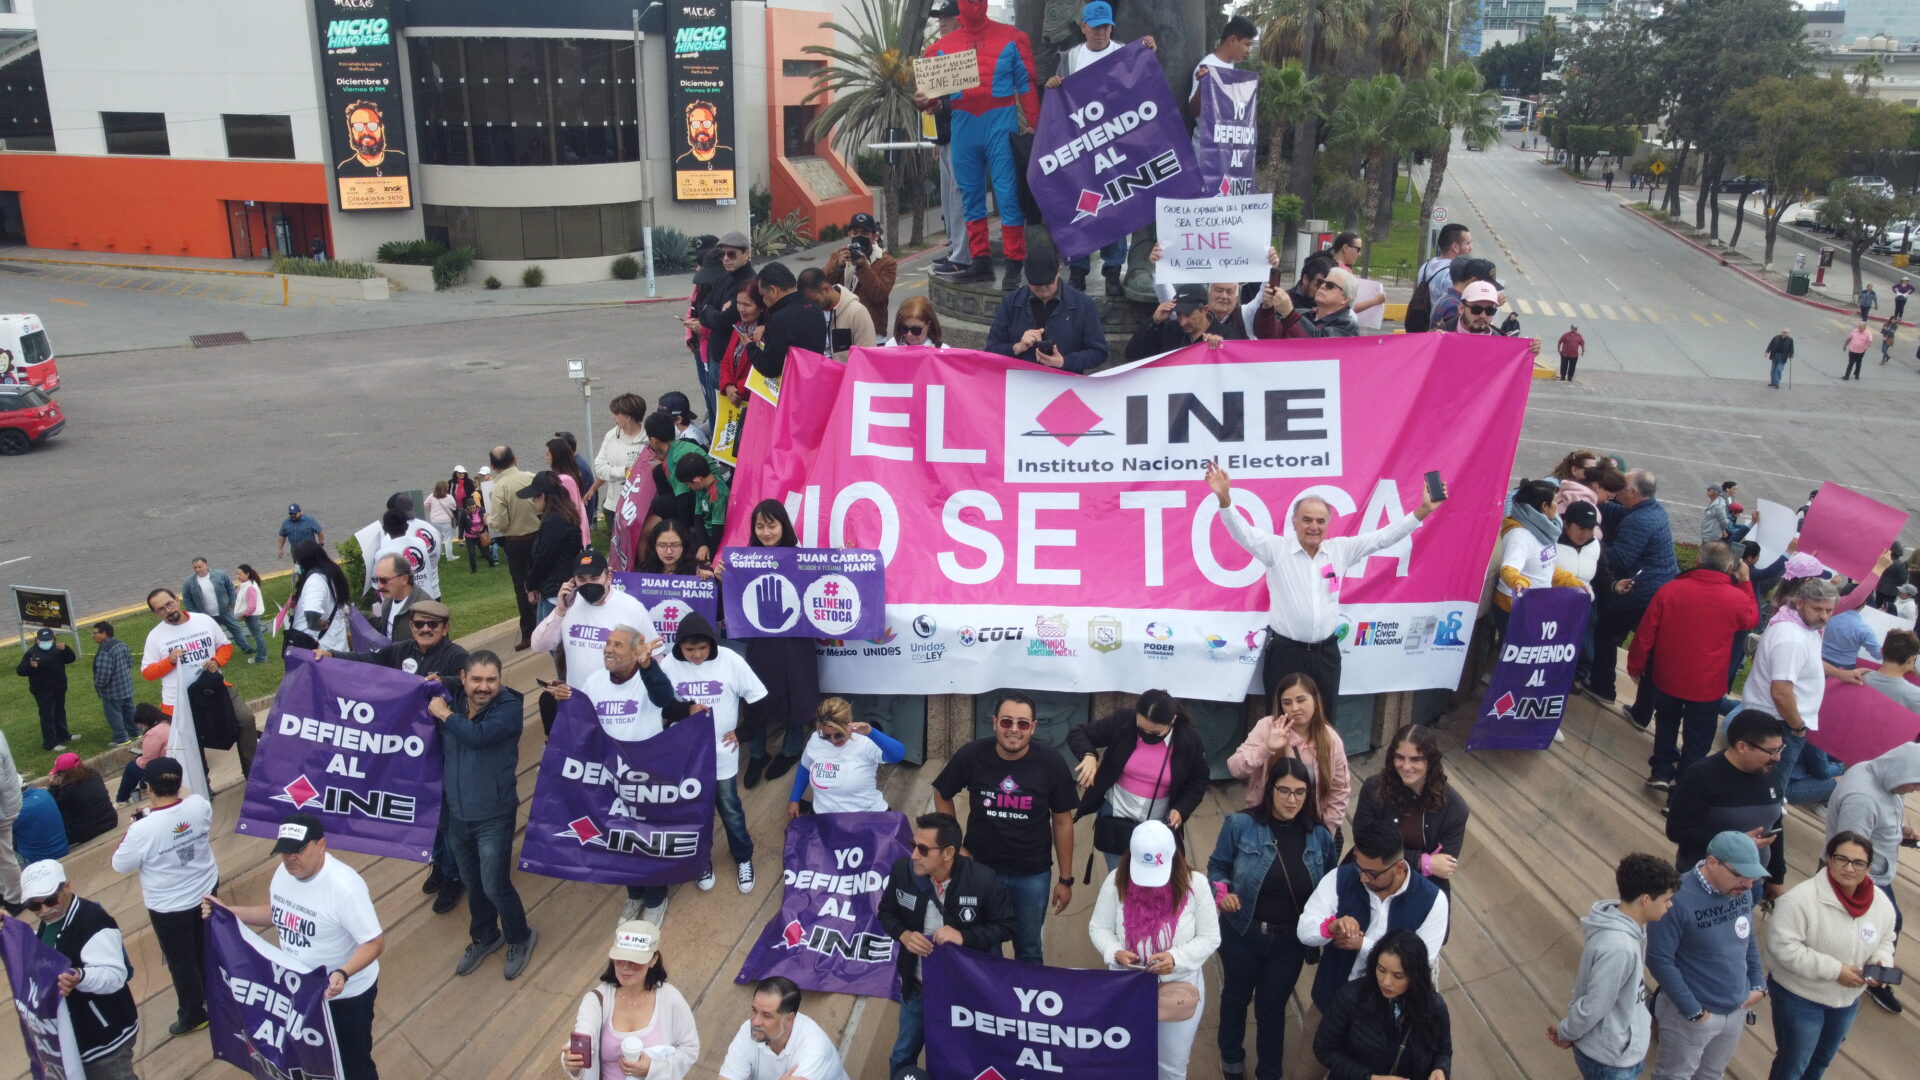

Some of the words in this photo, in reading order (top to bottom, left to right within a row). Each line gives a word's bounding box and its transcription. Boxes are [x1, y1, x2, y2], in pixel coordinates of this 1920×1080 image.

[327, 18, 389, 38] NICHO
[675, 26, 727, 43] NICHO
[327, 33, 390, 48] HINOJOSA
[675, 40, 727, 53] HINOJOSA
[928, 77, 949, 90] INE
[1068, 101, 1105, 129] YO
[1233, 102, 1245, 121] YO
[1038, 101, 1158, 176] DEFIENDO
[1213, 124, 1255, 145] DEFIENDO
[1094, 146, 1128, 175] AL
[1230, 150, 1243, 168] AL
[1104, 149, 1183, 205] INE
[1163, 205, 1181, 214] QUE
[1182, 206, 1192, 214] LA
[1226, 204, 1238, 212] DEL
[1175, 218, 1192, 228] SEA
[1180, 231, 1232, 251] INE
[1170, 258, 1181, 267] LA
[850, 380, 987, 464] EL
[1126, 388, 1328, 445] INE
[1017, 457, 1114, 473] Instituto
[1122, 453, 1219, 472] Nacional
[1227, 451, 1330, 469] Electoral
[936, 489, 1082, 586] SE
[797, 553, 828, 563] JUAN
[830, 553, 876, 563] CARLOS
[844, 563, 876, 573] HANK
[641, 578, 670, 588] JUAN
[671, 580, 714, 590] CARLOS
[682, 590, 714, 599] HANK
[812, 597, 853, 610] ELINENO
[813, 609, 853, 622] SETOCA
[580, 626, 601, 640] INE
[1376, 621, 1399, 630] Frente
[1541, 621, 1558, 640] YO
[977, 627, 1024, 643] COCI
[1030, 639, 1065, 649] DONANDO
[1373, 636, 1403, 645] Nacional
[826, 647, 858, 657] México
[863, 646, 902, 657] UNID@S
[910, 642, 946, 652] Unidos
[1143, 642, 1175, 652] PODER
[1502, 643, 1576, 665] DEFIENDO
[1525, 669, 1546, 687] AL
[689, 682, 710, 695] INE
[336, 697, 375, 724] YO
[605, 702, 625, 715] INE
[1514, 695, 1565, 720] INE
[278, 713, 425, 758] DEFIENDO
[325, 753, 366, 779] AL
[616, 754, 650, 783] YO
[322, 786, 416, 823] INE
[608, 797, 647, 821] AL
[997, 793, 1033, 810] INE
[986, 809, 997, 817] NO
[607, 829, 700, 858] INE
[834, 846, 863, 871] YO
[817, 897, 857, 922] AL
[631, 936, 648, 944] INE
[806, 925, 894, 963] INE
[1012, 986, 1063, 1017] YO
[950, 1004, 1131, 1050] DEFIENDO
[1015, 1047, 1064, 1074] AL
